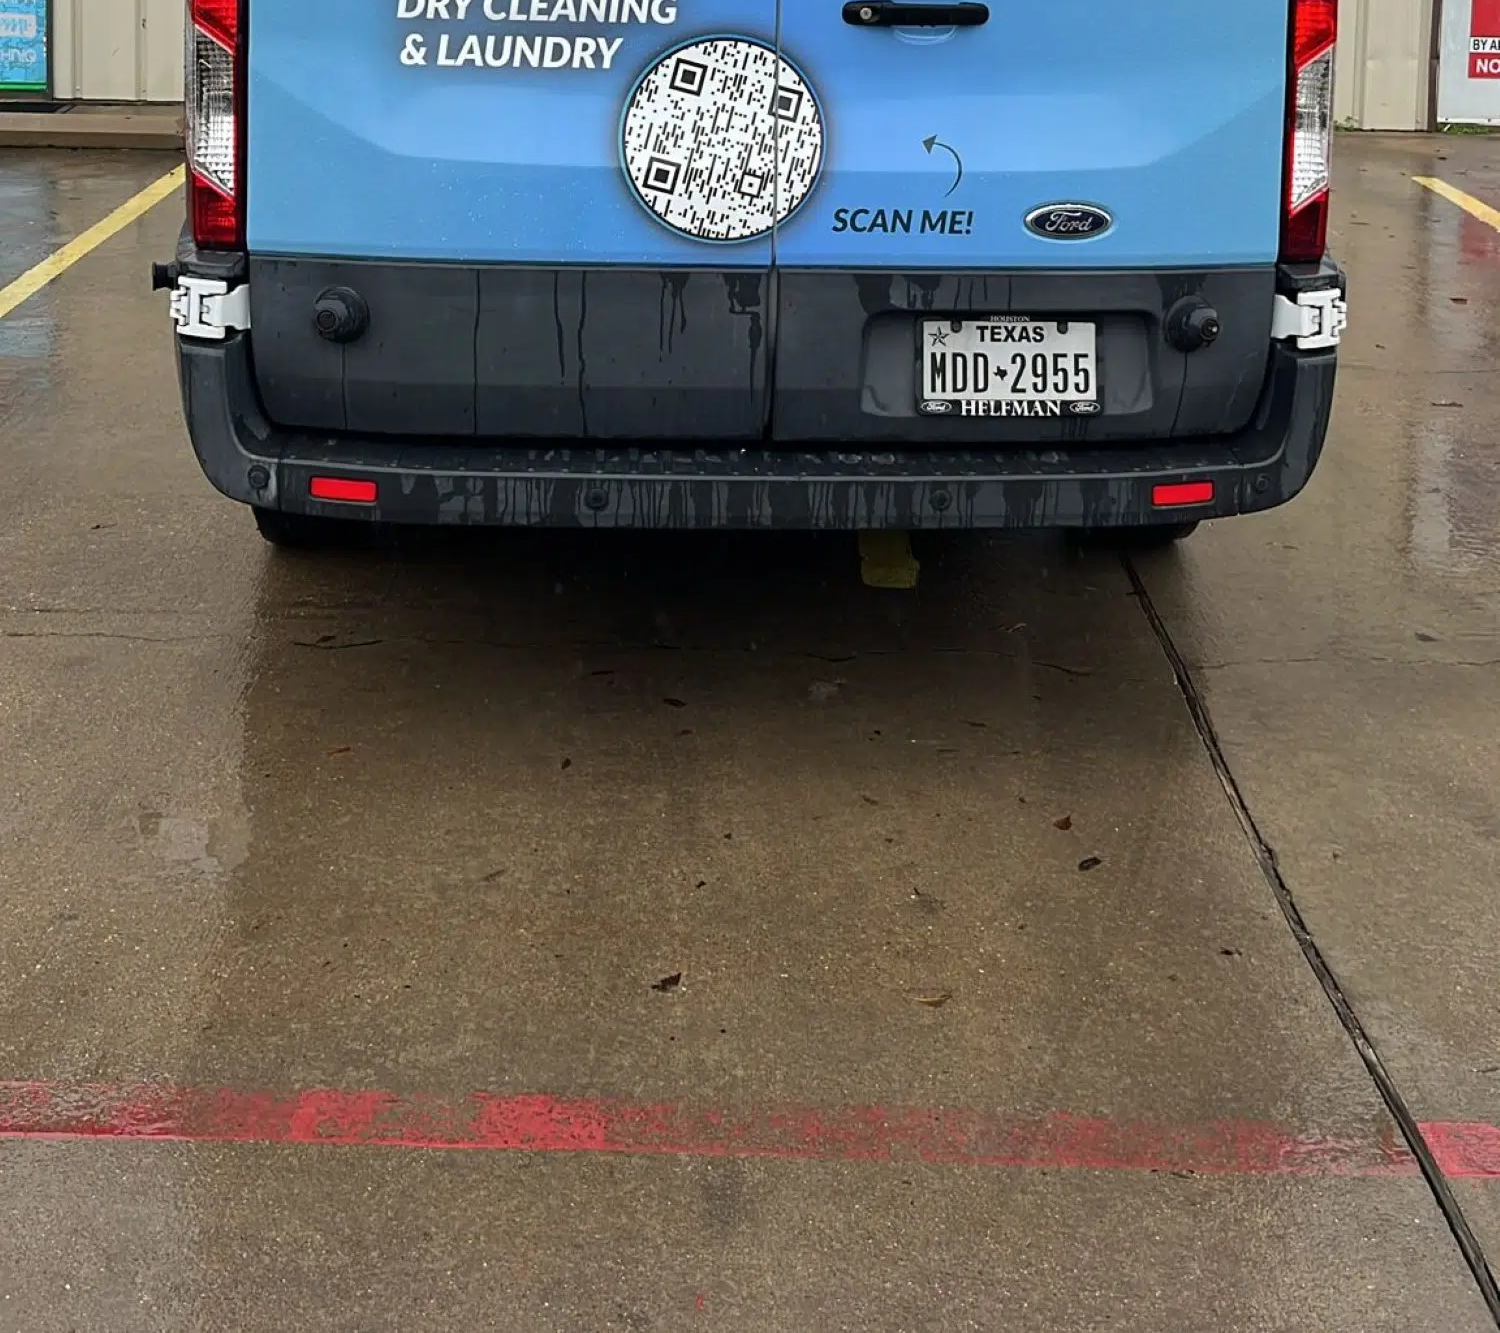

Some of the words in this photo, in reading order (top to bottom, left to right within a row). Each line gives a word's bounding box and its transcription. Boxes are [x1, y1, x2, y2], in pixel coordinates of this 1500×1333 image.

[400, 32, 427, 65] &
[436, 34, 623, 69] LAUNDRY
[1473, 39, 1488, 51] BY
[831, 207, 914, 234] SCAN
[919, 210, 974, 235] ME!
[1044, 210, 1093, 232] Ford
[975, 325, 1045, 343] TEXAS
[930, 351, 989, 393] MDD
[1010, 352, 1090, 394] 2955
[961, 400, 1062, 416] HELFMAN
